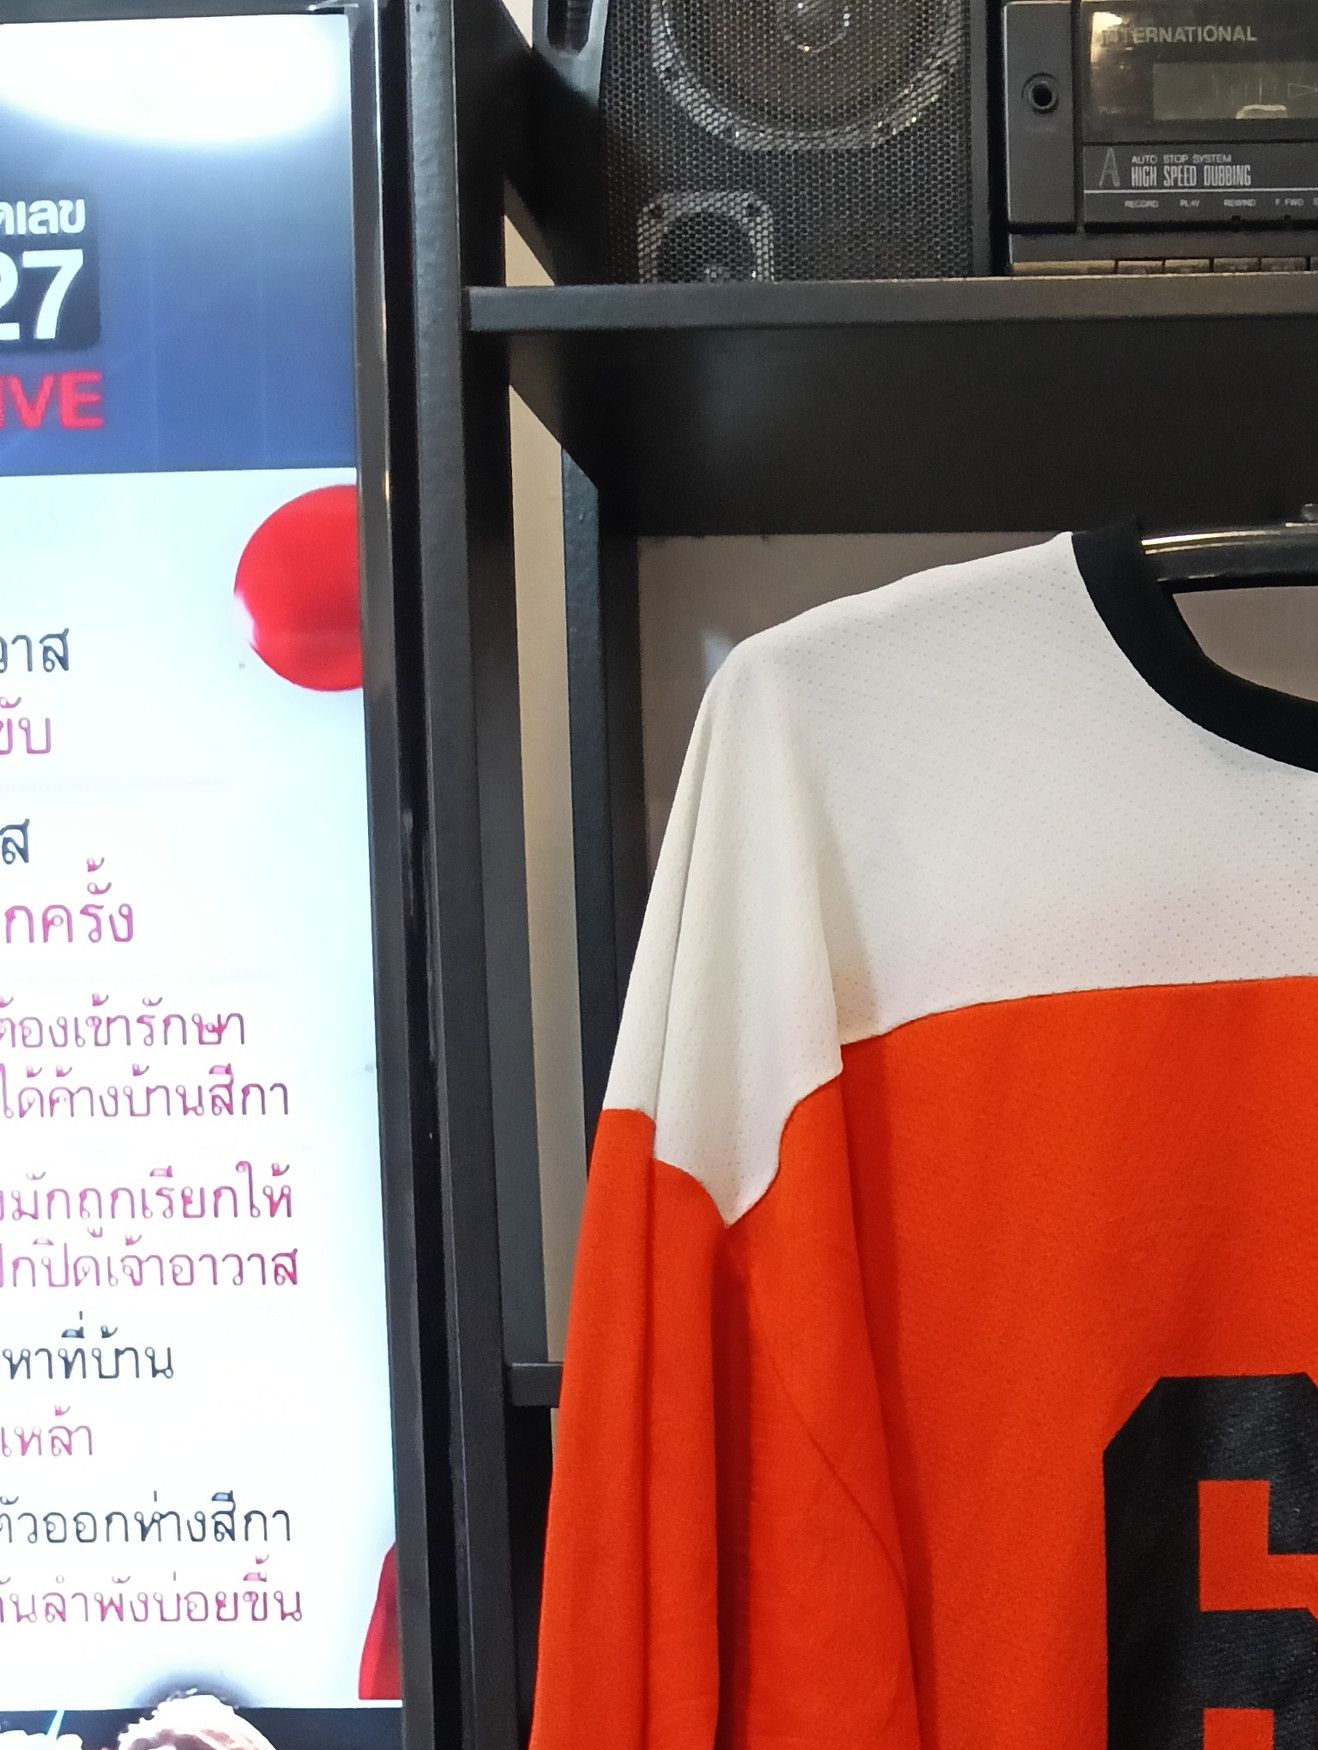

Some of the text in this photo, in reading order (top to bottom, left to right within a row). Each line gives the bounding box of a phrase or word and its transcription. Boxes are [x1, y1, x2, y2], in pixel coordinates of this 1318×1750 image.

[1131, 164, 1251, 187] HIGH SPEED DUBBING
[1132, 153, 1232, 164] AUTO STOP SYSTEM
[4, 856, 133, 943] กครั้ง
[0, 1160, 292, 1238] มักถูกเรียกให้
[0, 1235, 298, 1288] กปิดเจ้าอาวาส
[2, 1311, 174, 1380] หาที่บ้าน
[1, 1404, 93, 1457] เหล้า
[0, 1554, 302, 1623] ันลำพังบ่อยขึ้น
